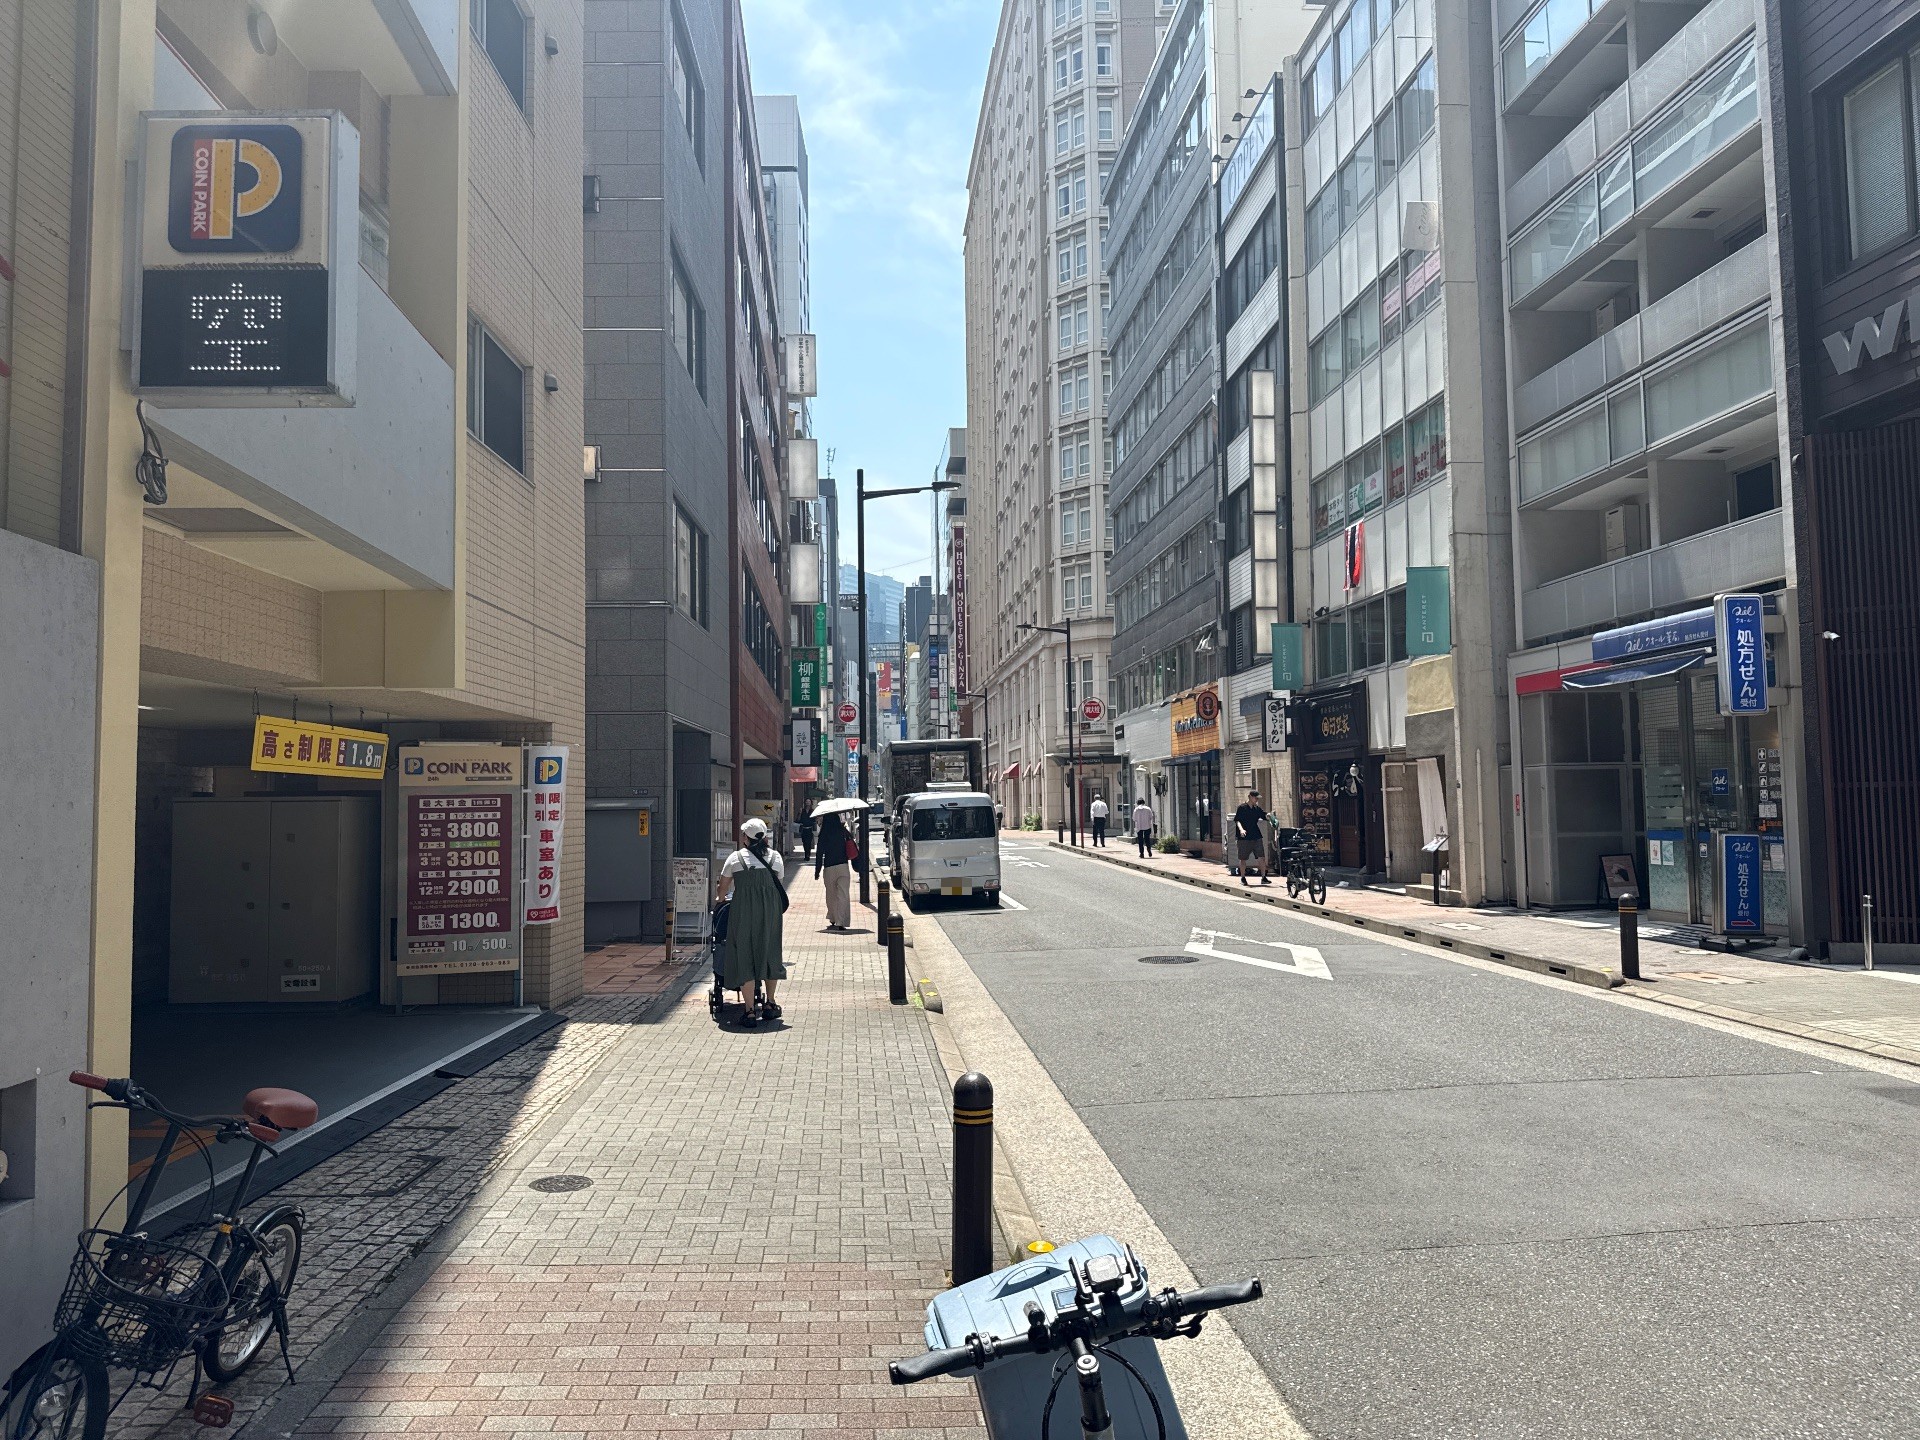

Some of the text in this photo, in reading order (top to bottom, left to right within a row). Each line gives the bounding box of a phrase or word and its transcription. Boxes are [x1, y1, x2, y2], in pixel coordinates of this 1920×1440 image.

[192, 147, 209, 233] COIN PARK
[190, 282, 282, 371] 空
[957, 592, 965, 648] Monterey
[798, 662, 814, 677] 柳
[957, 652, 965, 687] GINZA
[1736, 629, 1757, 698] 処方せん
[800, 676, 811, 700] 銀座本店
[840, 709, 855, 718] 消火栓
[1085, 706, 1100, 714] 消火栓
[1739, 698, 1758, 708] 受付
[261, 729, 333, 764] 高さ制限
[339, 741, 346, 764] 注意
[352, 742, 382, 768] 1.8m
[427, 762, 512, 774] COIN PARK
[422, 800, 467, 808] 最大料金
[534, 793, 546, 822] 割引
[548, 793, 561, 822] 限定
[538, 829, 555, 899] 車室あり
[1737, 862, 1750, 910] 処方せん
[283, 979, 317, 988] 変電設備
